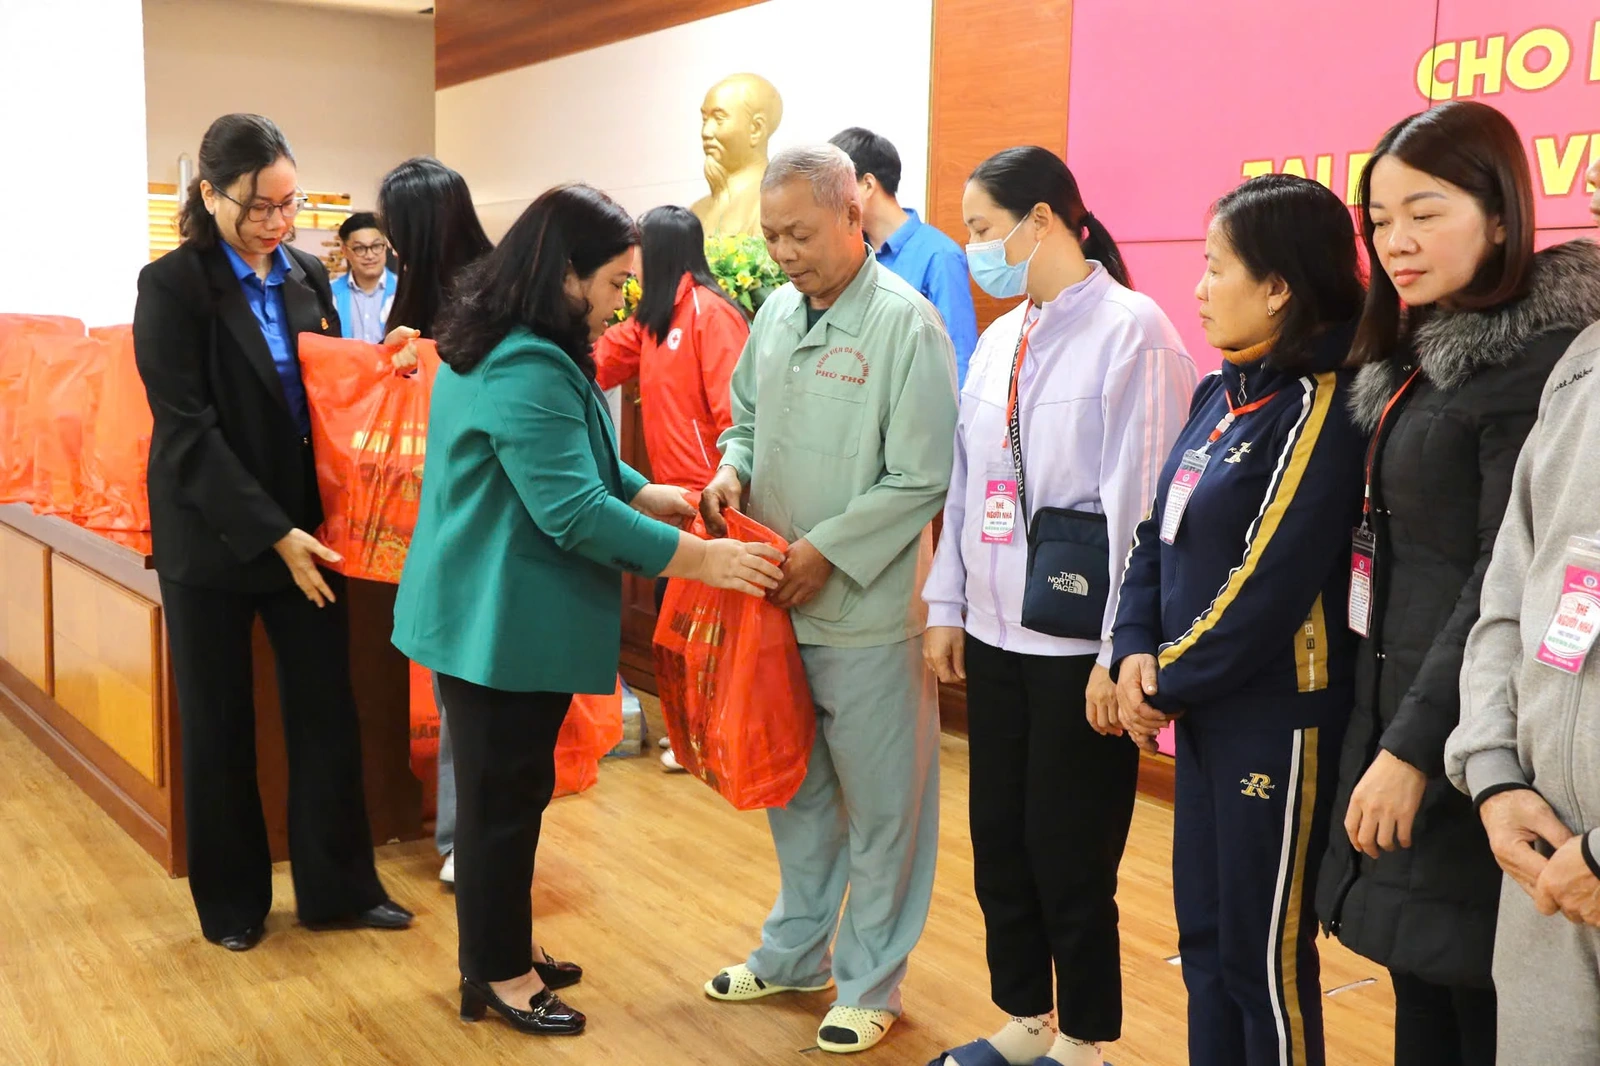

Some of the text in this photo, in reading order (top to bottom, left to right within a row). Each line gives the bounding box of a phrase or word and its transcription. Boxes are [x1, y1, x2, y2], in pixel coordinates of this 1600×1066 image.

[1416, 27, 1571, 101] CHO
[1047, 575, 1075, 586] NORTH
[1060, 571, 1077, 580] THE
[1052, 583, 1074, 593] FACE
